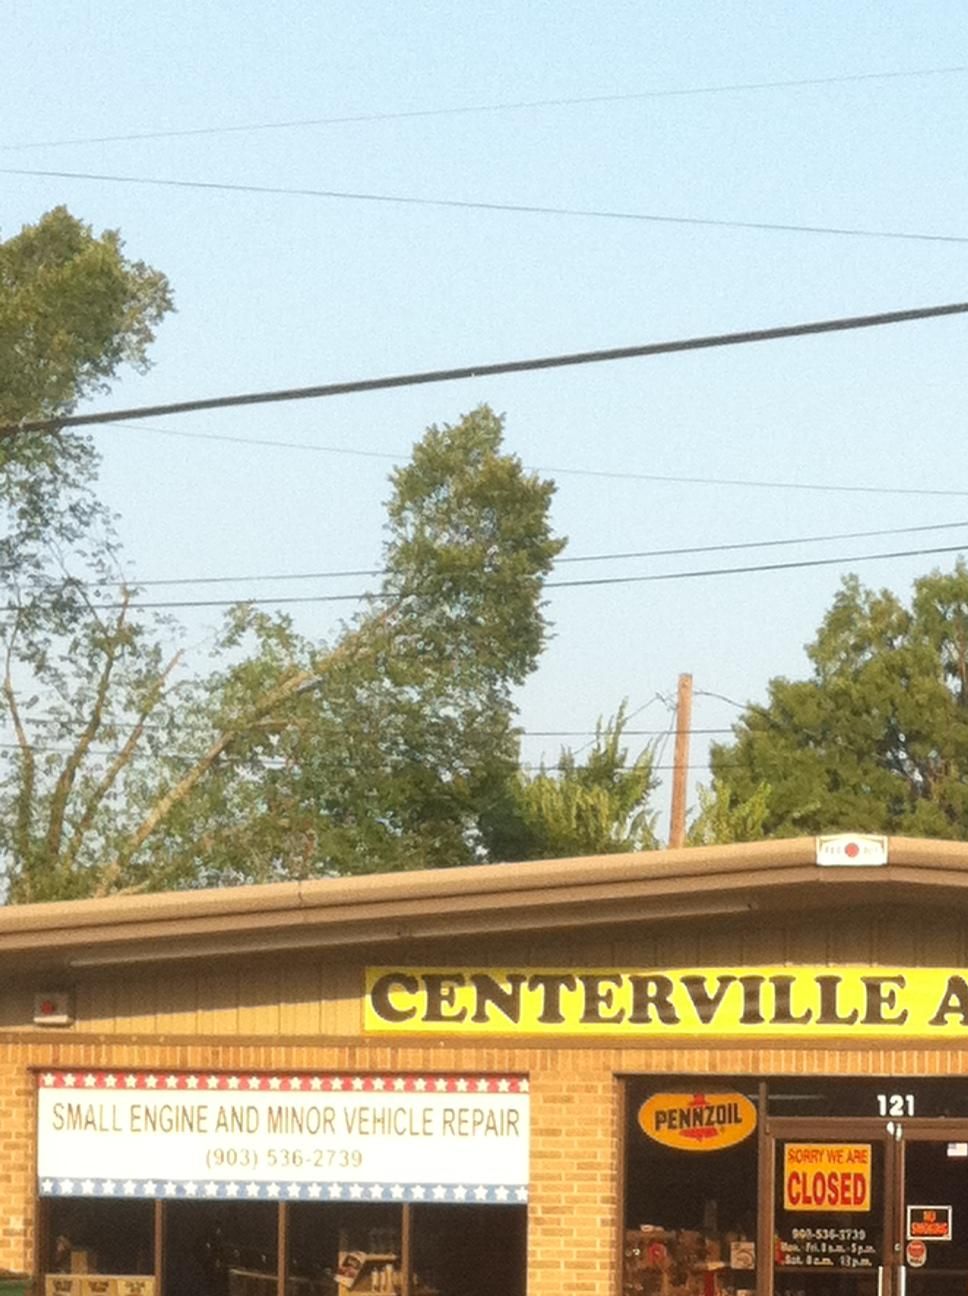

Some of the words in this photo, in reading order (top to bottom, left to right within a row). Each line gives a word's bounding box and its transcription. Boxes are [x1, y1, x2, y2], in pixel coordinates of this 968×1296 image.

[369, 972, 909, 1026] CENTERVILLE
[654, 1103, 743, 1131] PENNZOIL
[876, 1094, 915, 1117] 121
[52, 1103, 123, 1132] SMALL
[130, 1104, 209, 1133] ENGINE
[215, 1105, 260, 1134] AND
[267, 1105, 336, 1135] MINOR
[343, 1106, 434, 1136] VEHICLE
[442, 1107, 520, 1137] REPAIR
[205, 1148, 259, 1170] (903)
[267, 1148, 363, 1168] 536-2739
[788, 1148, 824, 1164] SORRY
[826, 1149, 845, 1164] WE
[846, 1149, 868, 1164] ARE
[787, 1170, 867, 1206] CLOSED
